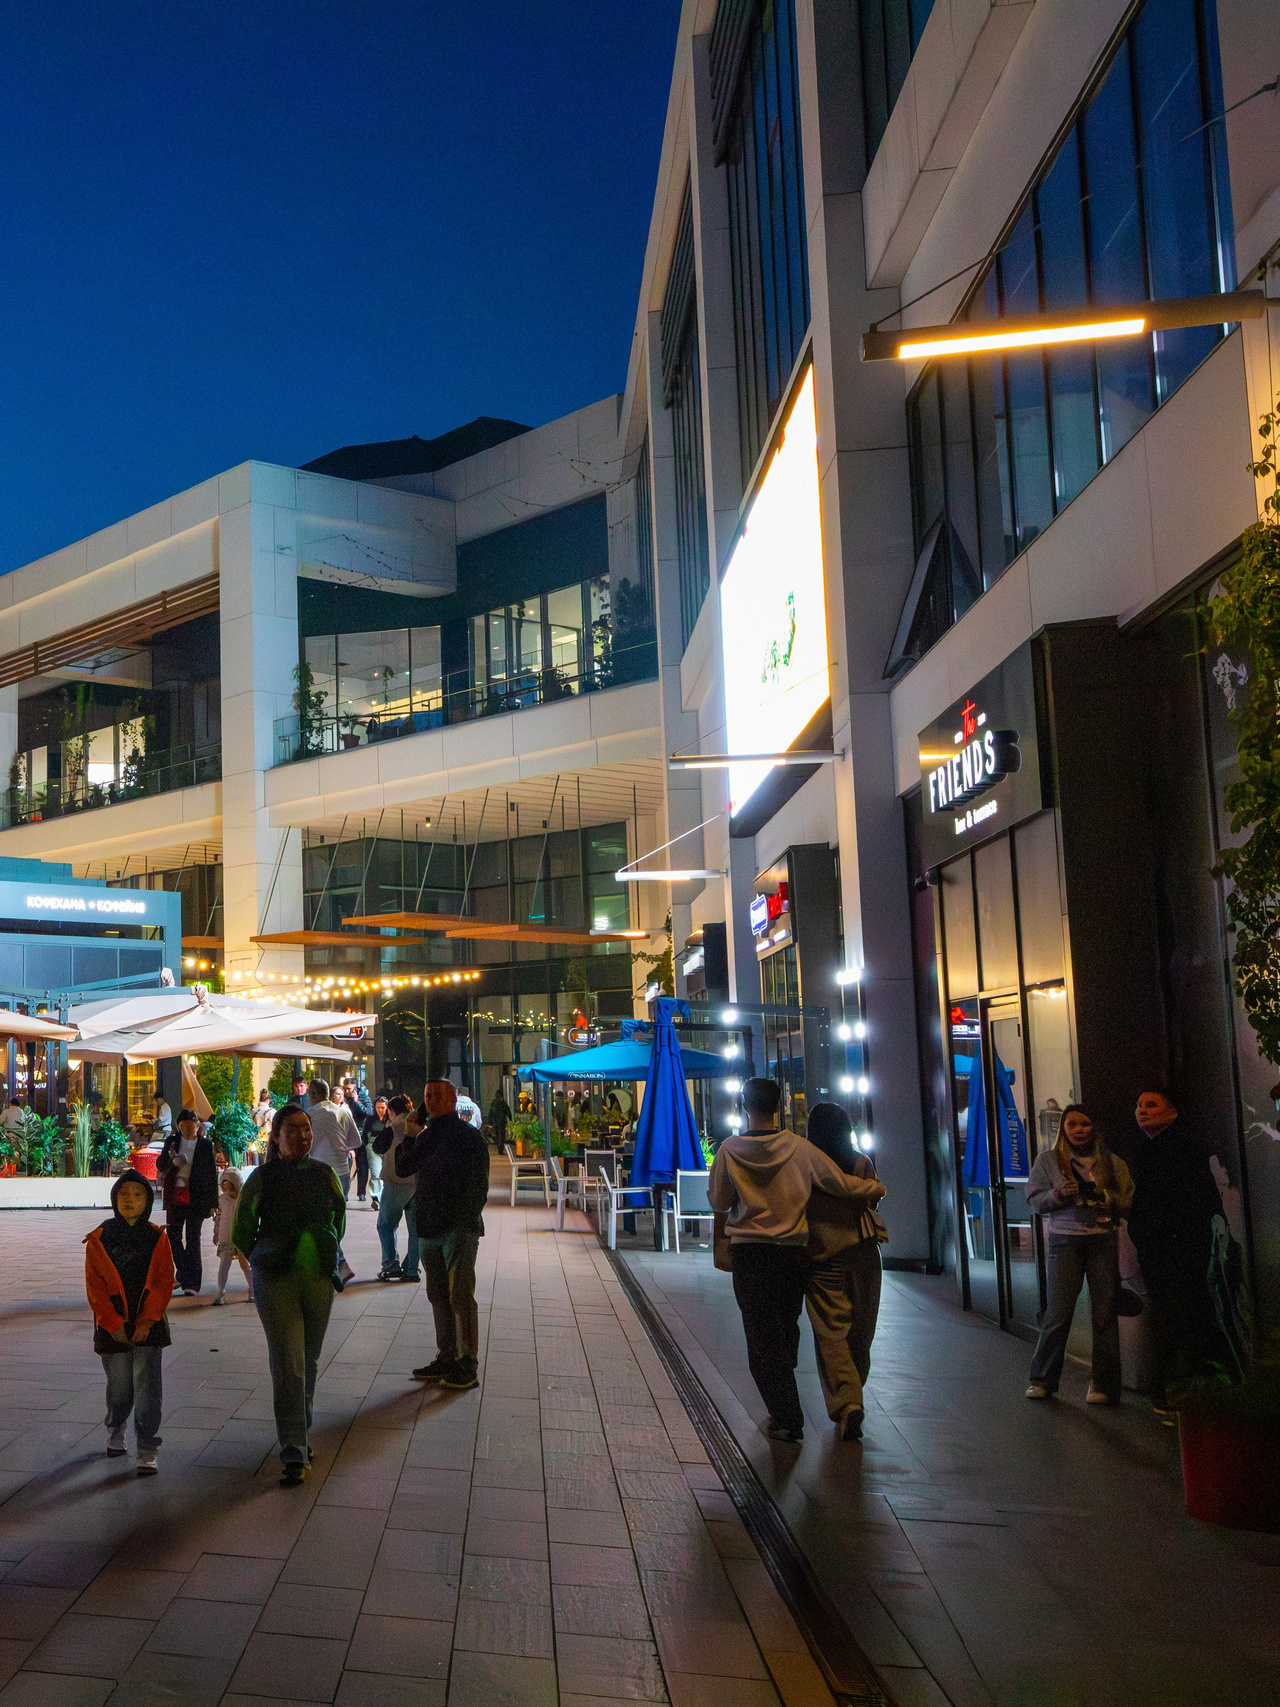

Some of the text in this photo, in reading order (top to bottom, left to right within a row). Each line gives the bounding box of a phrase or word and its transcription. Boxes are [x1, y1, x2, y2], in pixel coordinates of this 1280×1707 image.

[928, 729, 996, 814] FRIENDS
[26, 896, 146, 914] КОФЕХАНА КОФЕЙНЯ
